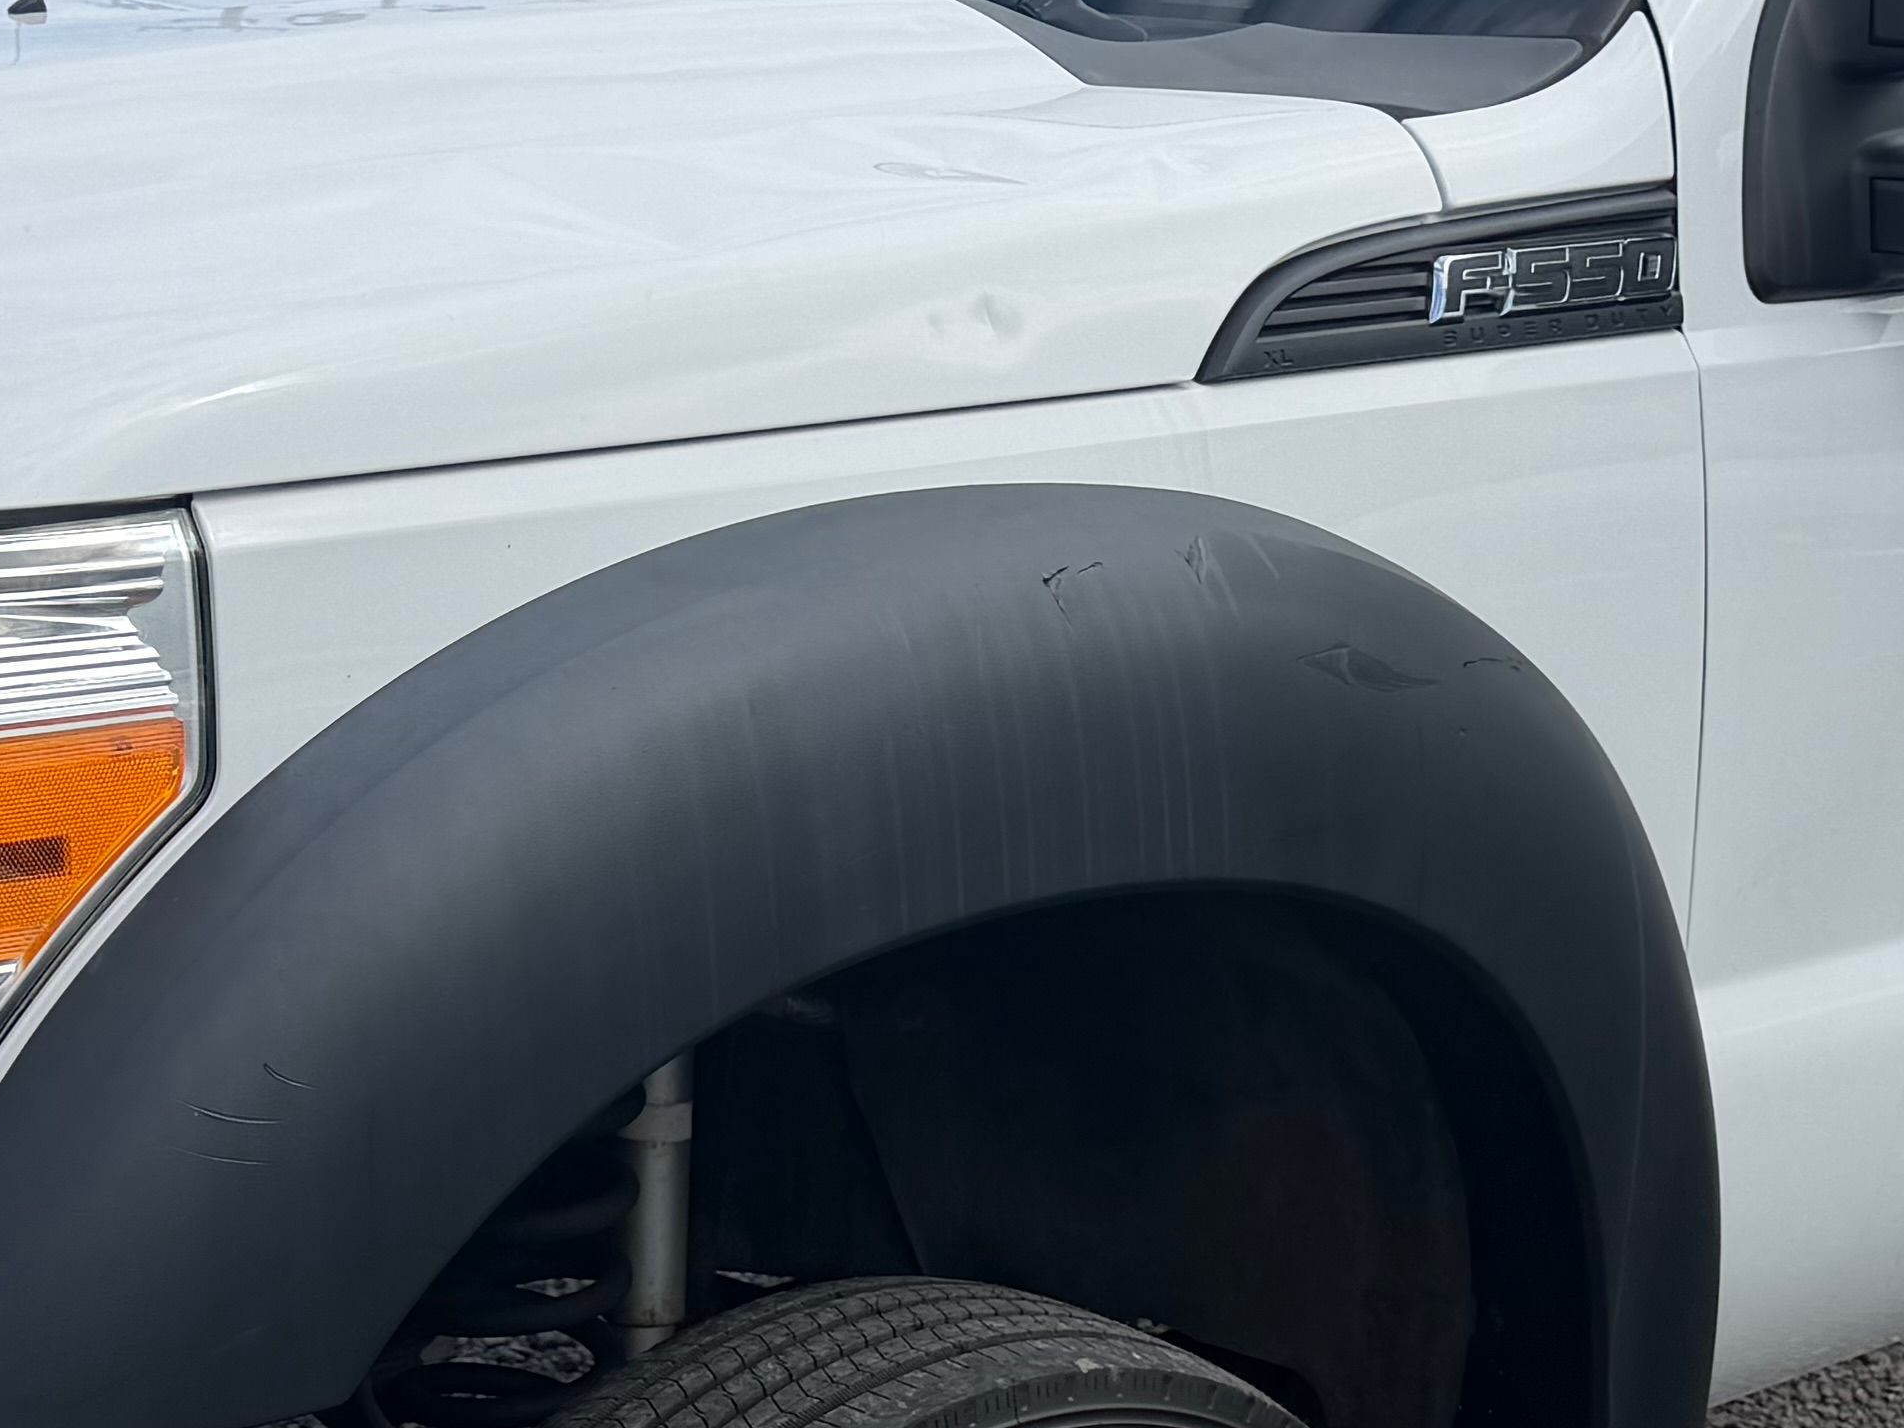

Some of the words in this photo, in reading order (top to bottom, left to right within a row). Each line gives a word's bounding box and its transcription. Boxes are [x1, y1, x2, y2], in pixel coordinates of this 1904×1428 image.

[1443, 319, 1566, 348] SUPER
[1584, 303, 1675, 332] DUTY
[1262, 346, 1297, 370] XL
